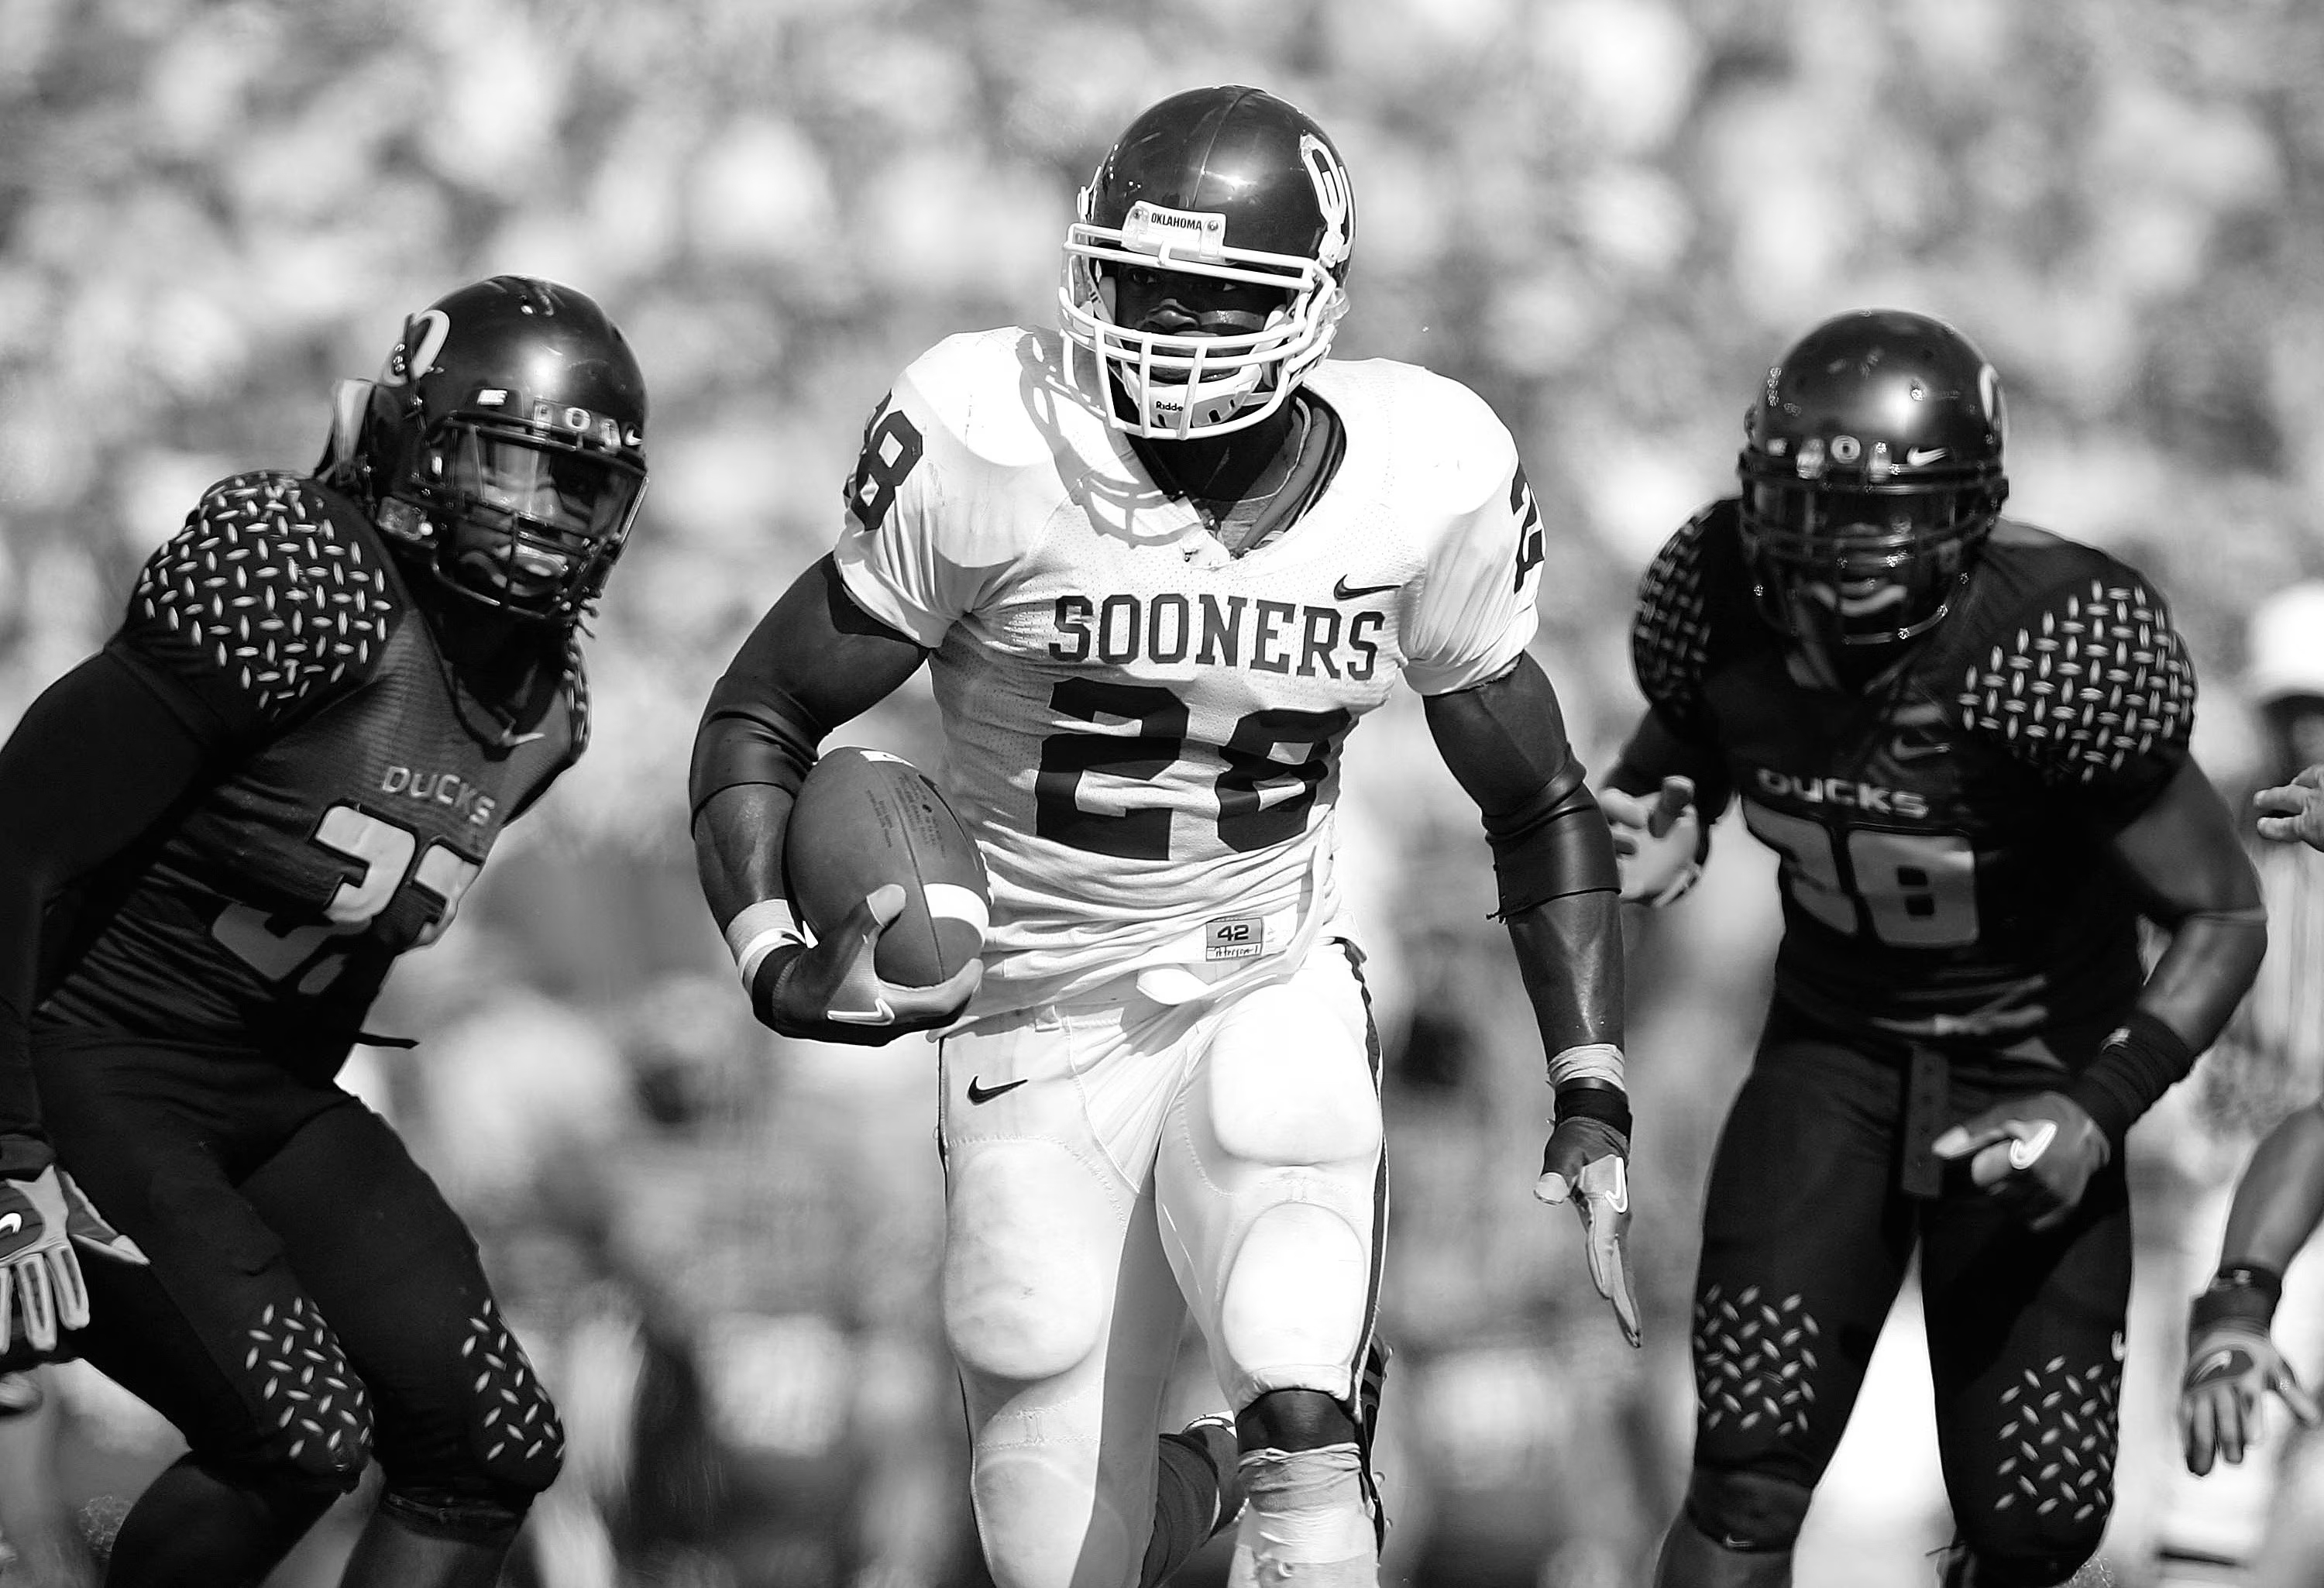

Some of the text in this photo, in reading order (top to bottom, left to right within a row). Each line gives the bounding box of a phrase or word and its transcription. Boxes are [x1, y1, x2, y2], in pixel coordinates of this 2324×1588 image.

[1150, 212, 1202, 231] OKLAHOMA
[1156, 400, 1184, 412] Ridde
[843, 387, 923, 528] 8
[1049, 593, 1385, 682] SOONERS
[382, 766, 496, 827] DUCKS
[1035, 676, 1352, 861] 28
[1756, 768, 1930, 820] DUCKS
[1217, 924, 1250, 942] 42
